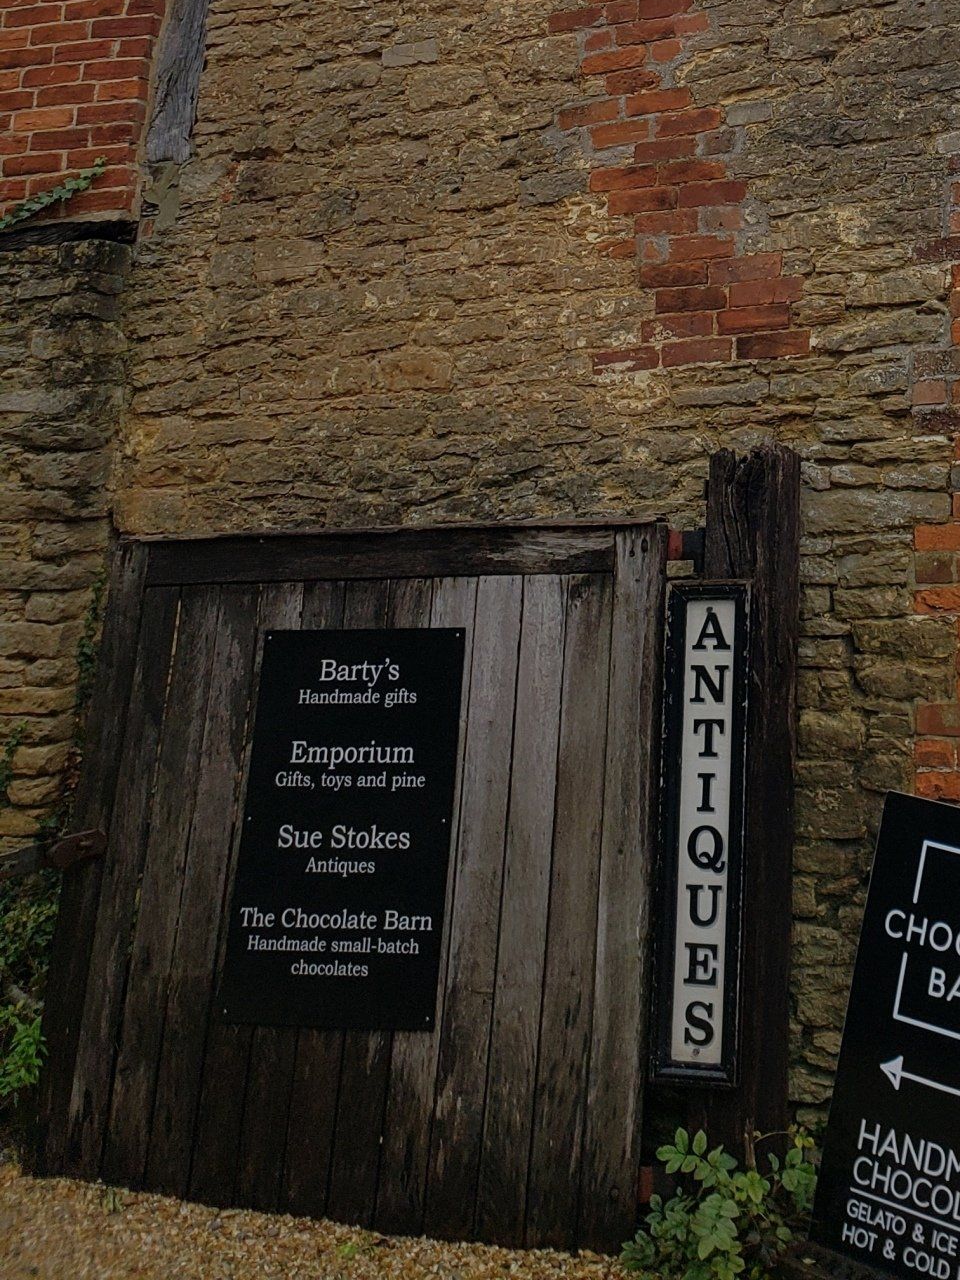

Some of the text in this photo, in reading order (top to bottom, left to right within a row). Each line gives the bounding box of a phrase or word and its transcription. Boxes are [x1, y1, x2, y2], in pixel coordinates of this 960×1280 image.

[320, 657, 400, 687] Barty’s
[298, 688, 417, 708] Handmade gifts
[289, 741, 415, 770] Emporium
[275, 771, 426, 792] Gifts, toys and pine
[278, 824, 411, 850] Sue Stokes
[684, 610, 731, 1047] ANTIQUES
[305, 856, 376, 878] Antiques
[240, 907, 433, 931] The Chocolate Barn
[247, 935, 420, 954] Handmade small-batch
[291, 959, 369, 977] chocolates
[846, 1199, 907, 1236] GELATO
[912, 1223, 925, 1244] &
[931, 1230, 959, 1257] ICE
[842, 1223, 878, 1252] HOT
[883, 1239, 896, 1261] &
[903, 1247, 951, 1280] COLD
